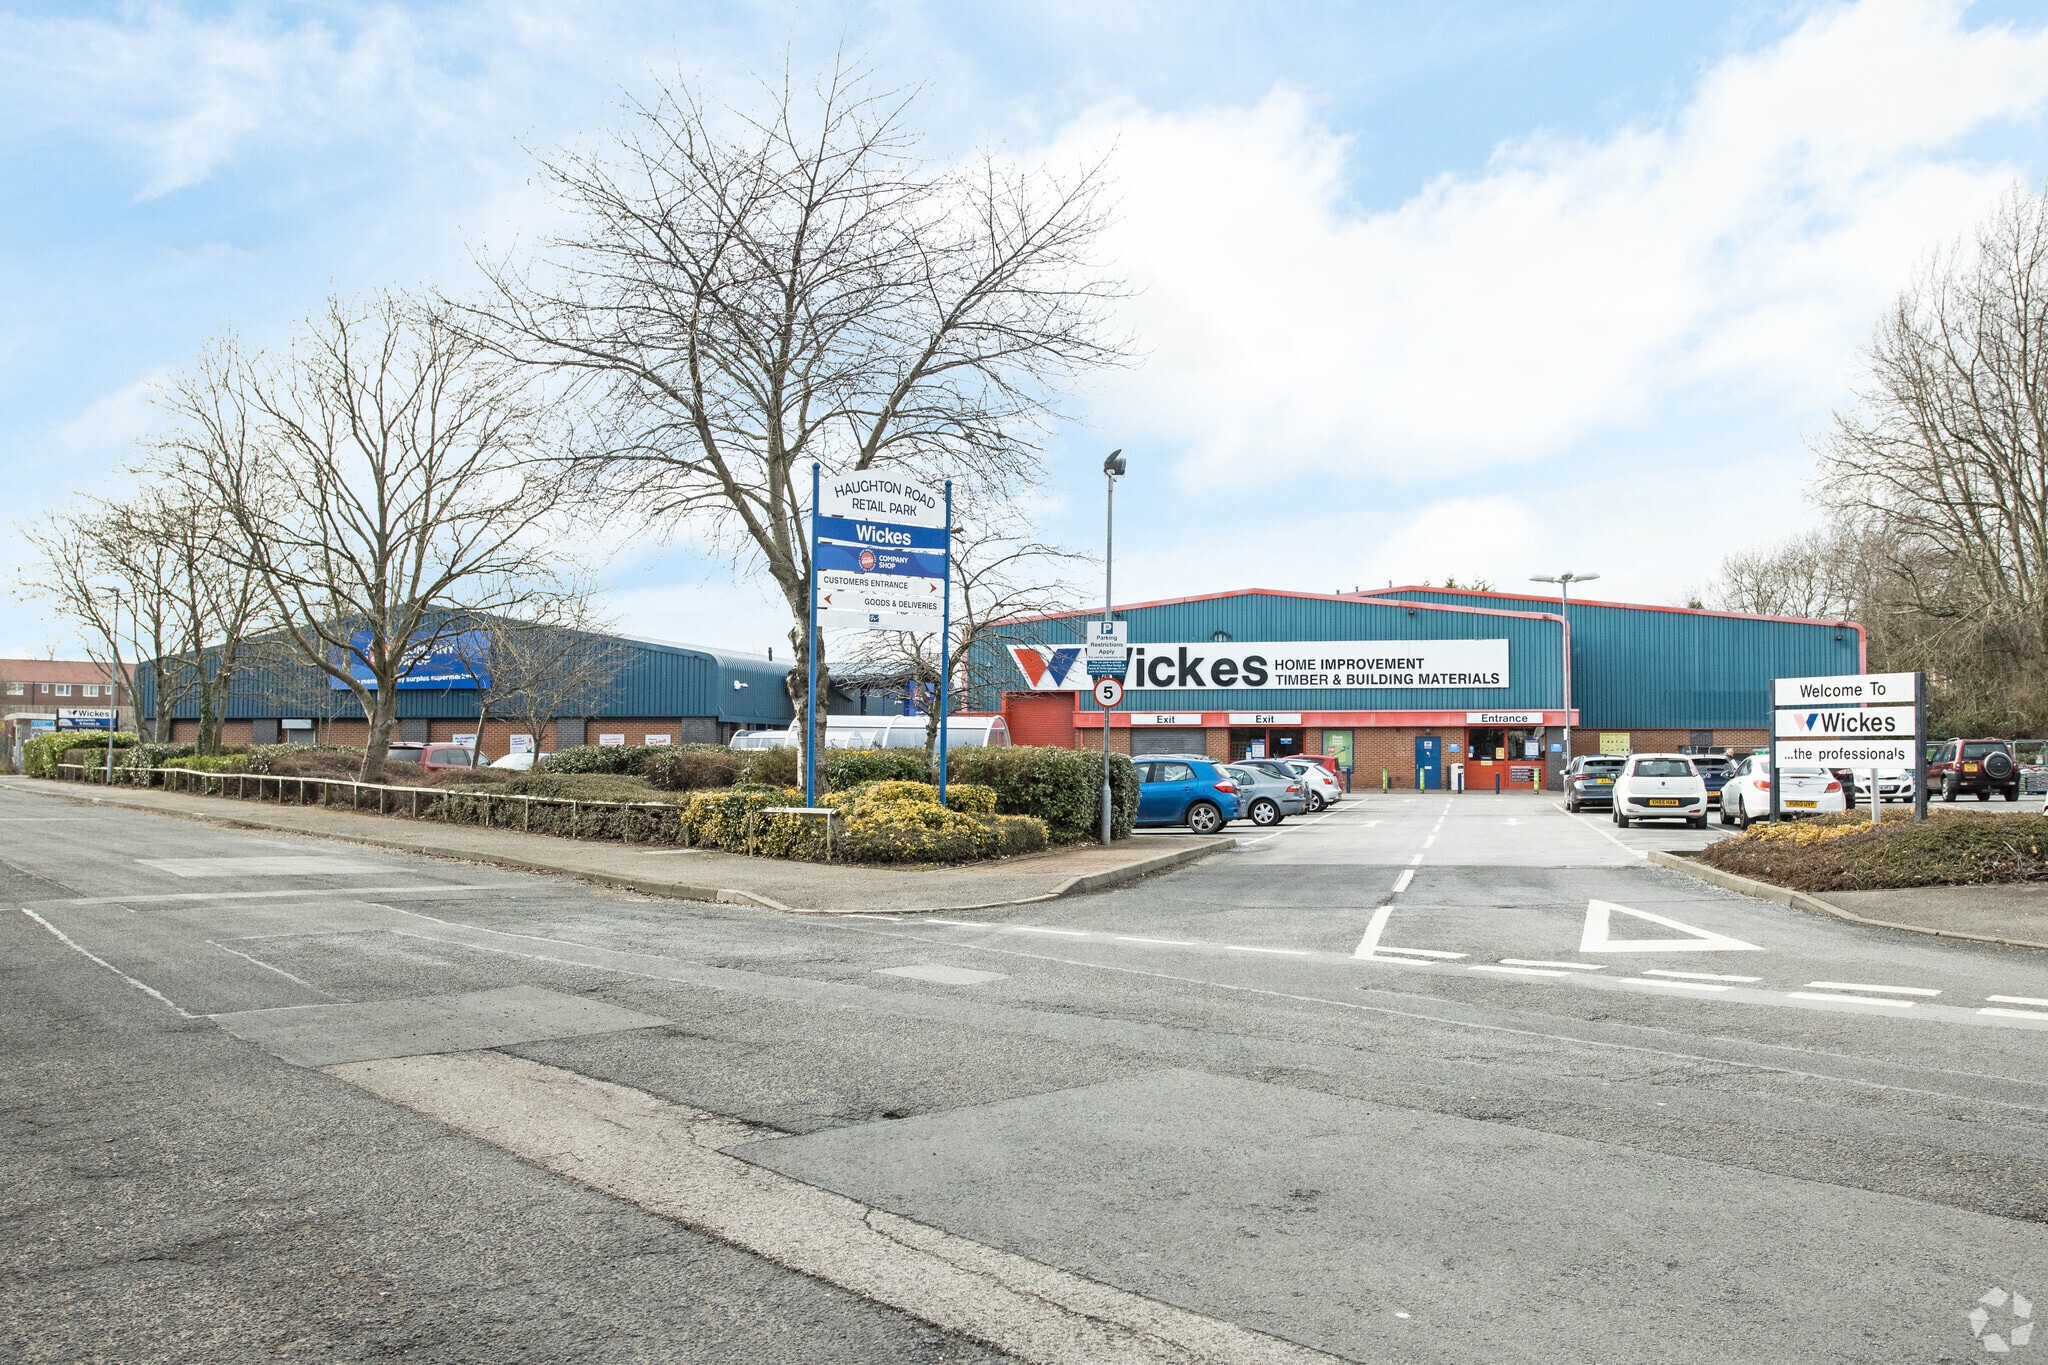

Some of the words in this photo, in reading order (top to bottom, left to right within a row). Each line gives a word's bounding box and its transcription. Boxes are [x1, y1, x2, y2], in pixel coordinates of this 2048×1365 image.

[834, 480, 902, 498] HAUGHTON
[904, 486, 936, 509] ROAD
[852, 498, 886, 512] RETAIL
[890, 502, 917, 516] PARK
[856, 524, 912, 546] Wickes
[878, 555, 908, 564] COMPANY
[824, 576, 869, 586] CUSTOMERS
[871, 580, 908, 589] ENTRANCE
[864, 598, 890, 606] GOODS
[898, 600, 938, 610] DELIVERIES
[1275, 659, 1316, 670] HOME
[1320, 658, 1424, 670] IMPROVEMENT
[1275, 674, 1328, 685] TIMBER
[1332, 674, 1342, 685] &
[1346, 674, 1414, 685] BUILDING
[1418, 673, 1500, 685] MATERIALS
[1103, 686, 1113, 699] 5
[1800, 684, 1862, 698] Welcome
[1870, 682, 1886, 695] To
[1157, 715, 1175, 724] Exit
[1256, 715, 1274, 723] Exit
[1482, 714, 1528, 722] Entrance
[1821, 712, 1895, 732] Wickes
[1784, 748, 1812, 760] ...the
[1820, 747, 1905, 762] professionals
